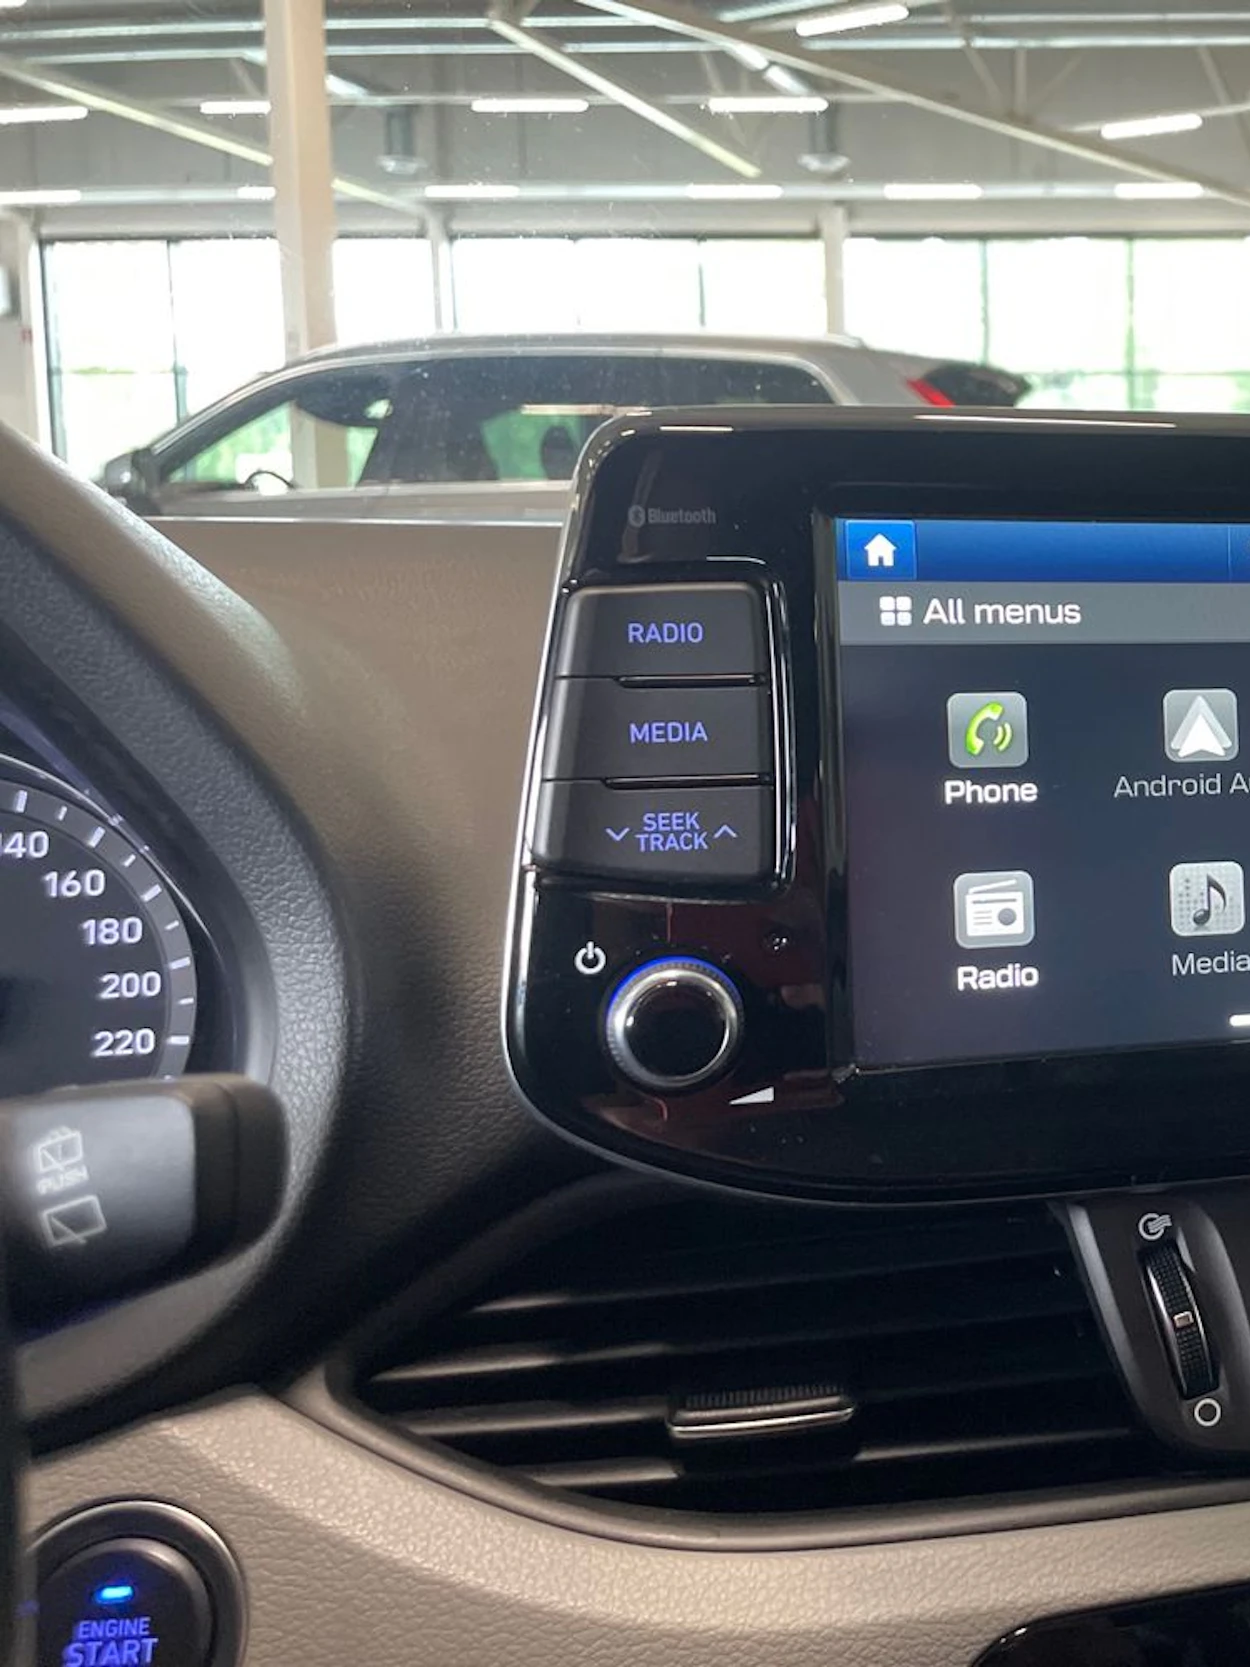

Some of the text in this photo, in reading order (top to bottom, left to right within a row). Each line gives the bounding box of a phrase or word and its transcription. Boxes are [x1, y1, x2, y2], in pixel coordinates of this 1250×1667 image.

[647, 507, 716, 525] Bluetooth
[922, 597, 1082, 626] All menus
[627, 622, 704, 644] RADIO
[629, 722, 709, 744] MEDIA
[943, 779, 1039, 805] Phone
[1113, 771, 1222, 799] Android
[642, 812, 700, 832] SEEK
[635, 831, 709, 853] TRACK
[43, 869, 106, 899] 160
[81, 916, 144, 945] 180
[98, 971, 162, 1000] 200
[956, 962, 1039, 992] Radio
[90, 1028, 156, 1057] 220
[74, 1616, 151, 1639] ENGINE
[63, 1637, 159, 1667] START
